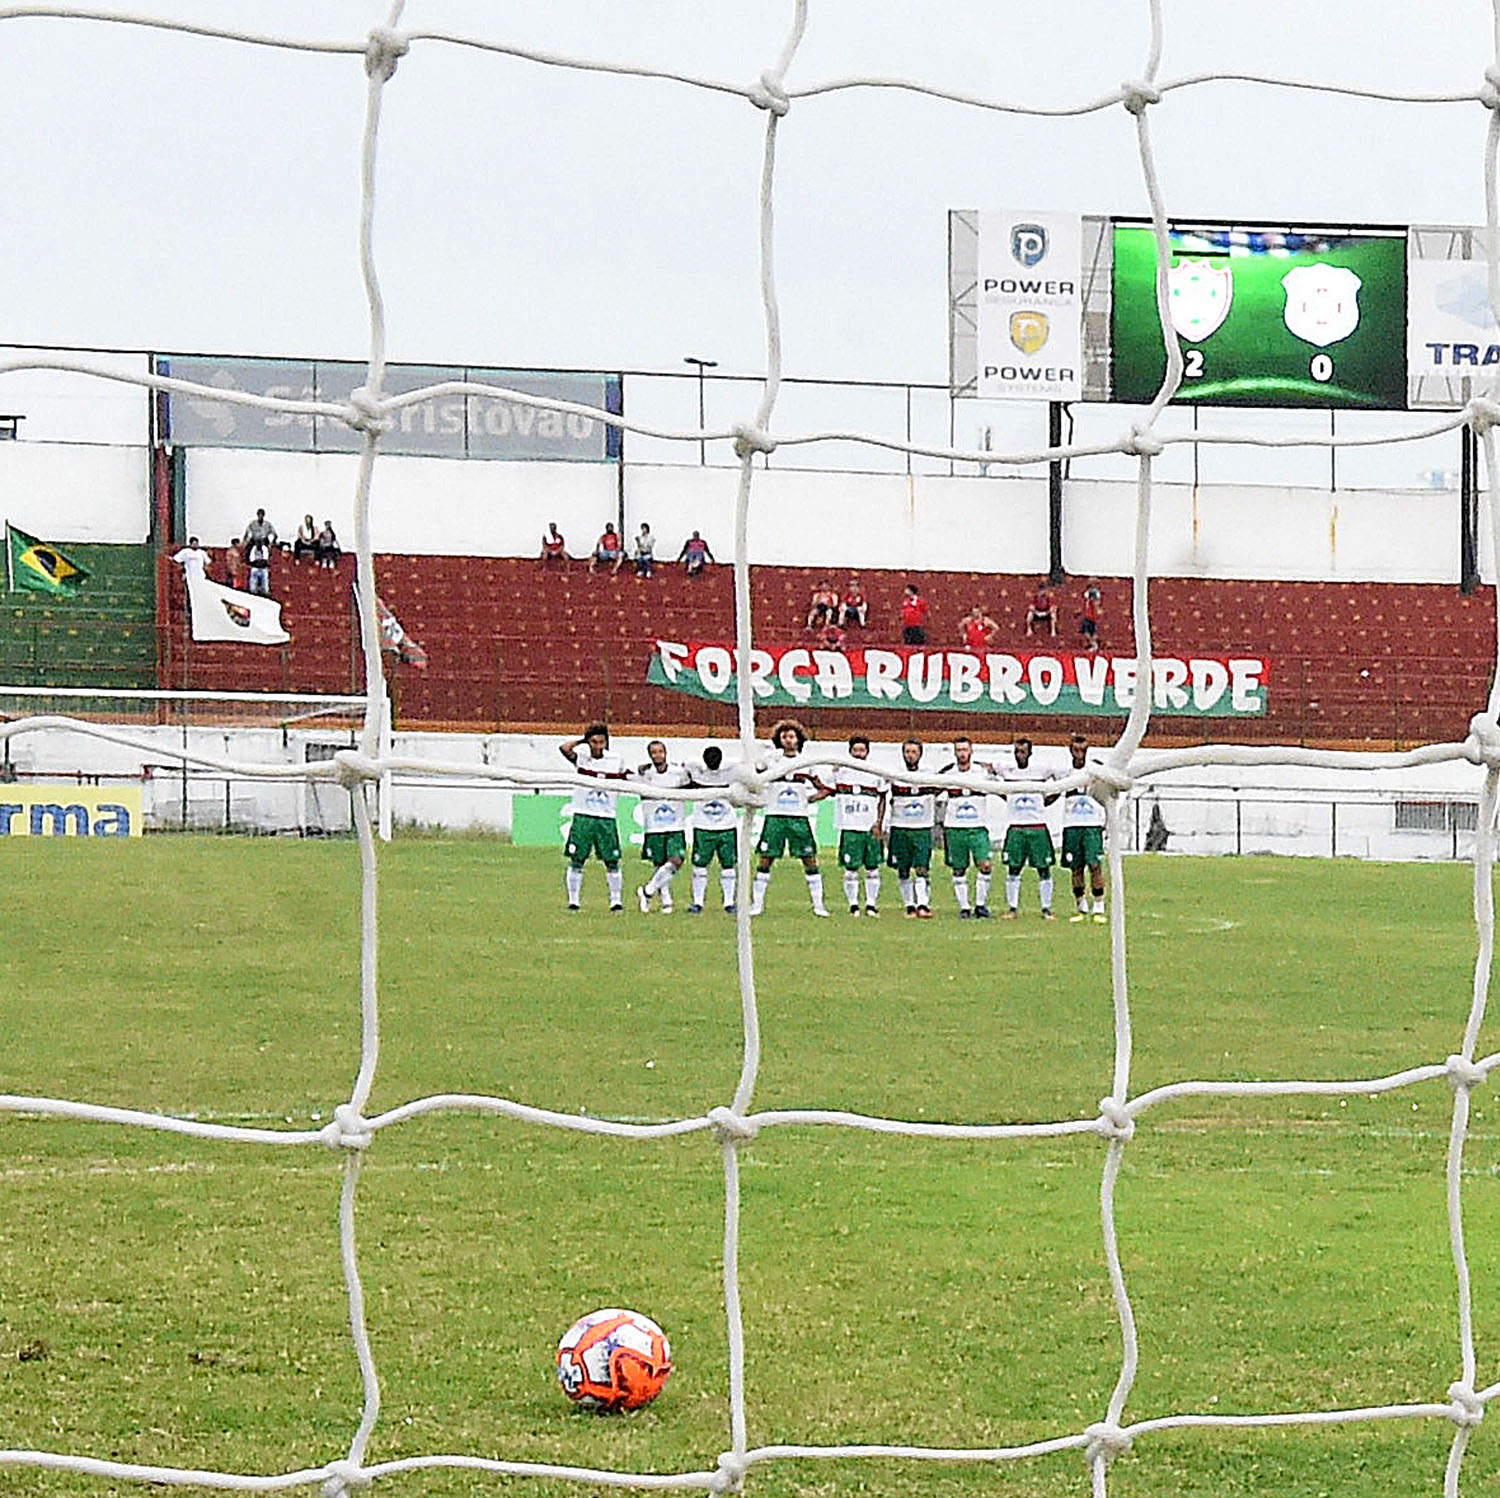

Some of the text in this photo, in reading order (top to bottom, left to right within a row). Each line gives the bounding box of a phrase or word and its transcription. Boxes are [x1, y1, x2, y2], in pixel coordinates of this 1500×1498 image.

[984, 279, 1074, 295] POWER
[984, 366, 1074, 382] POWER
[1184, 350, 1205, 377] 2
[1310, 352, 1334, 382] 0
[657, 640, 1264, 712] FORÇA RUBRO VERDE
